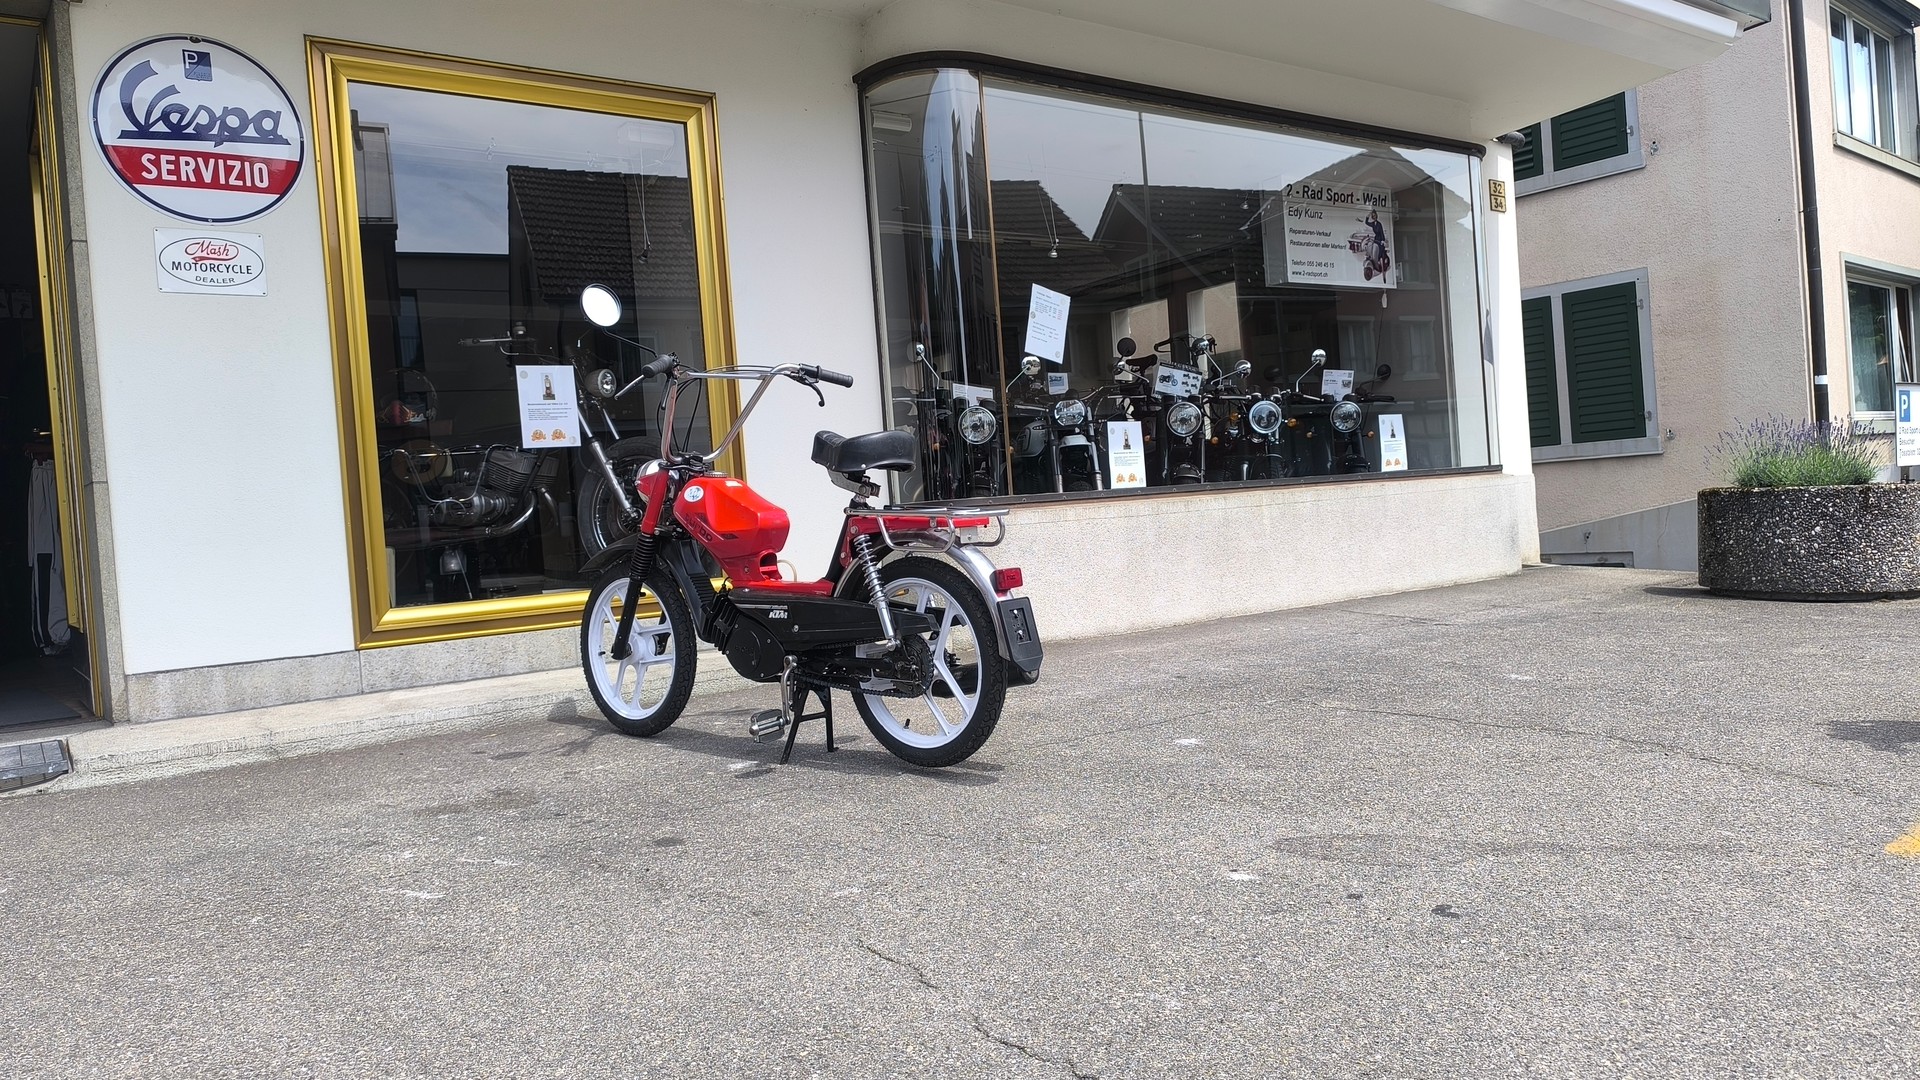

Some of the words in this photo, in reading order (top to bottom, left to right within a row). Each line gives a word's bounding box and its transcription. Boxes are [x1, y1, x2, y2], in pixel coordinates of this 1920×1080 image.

[117, 59, 291, 148] Vespa
[140, 153, 269, 188] SERVIZIO
[1286, 183, 1293, 197] 2
[1302, 185, 1323, 200] Rad
[1326, 188, 1354, 205] Sport
[1362, 192, 1387, 207] Wald
[1493, 182, 1503, 195] 32
[1494, 197, 1503, 210] 34
[1288, 206, 1303, 219] Edy
[1304, 208, 1323, 219] Kunz
[185, 240, 234, 259] Mash
[171, 261, 253, 275] MOTORCYCLE
[1291, 259, 1306, 267] Telefon
[195, 275, 236, 284] DEALER
[769, 609, 788, 619] KTM
